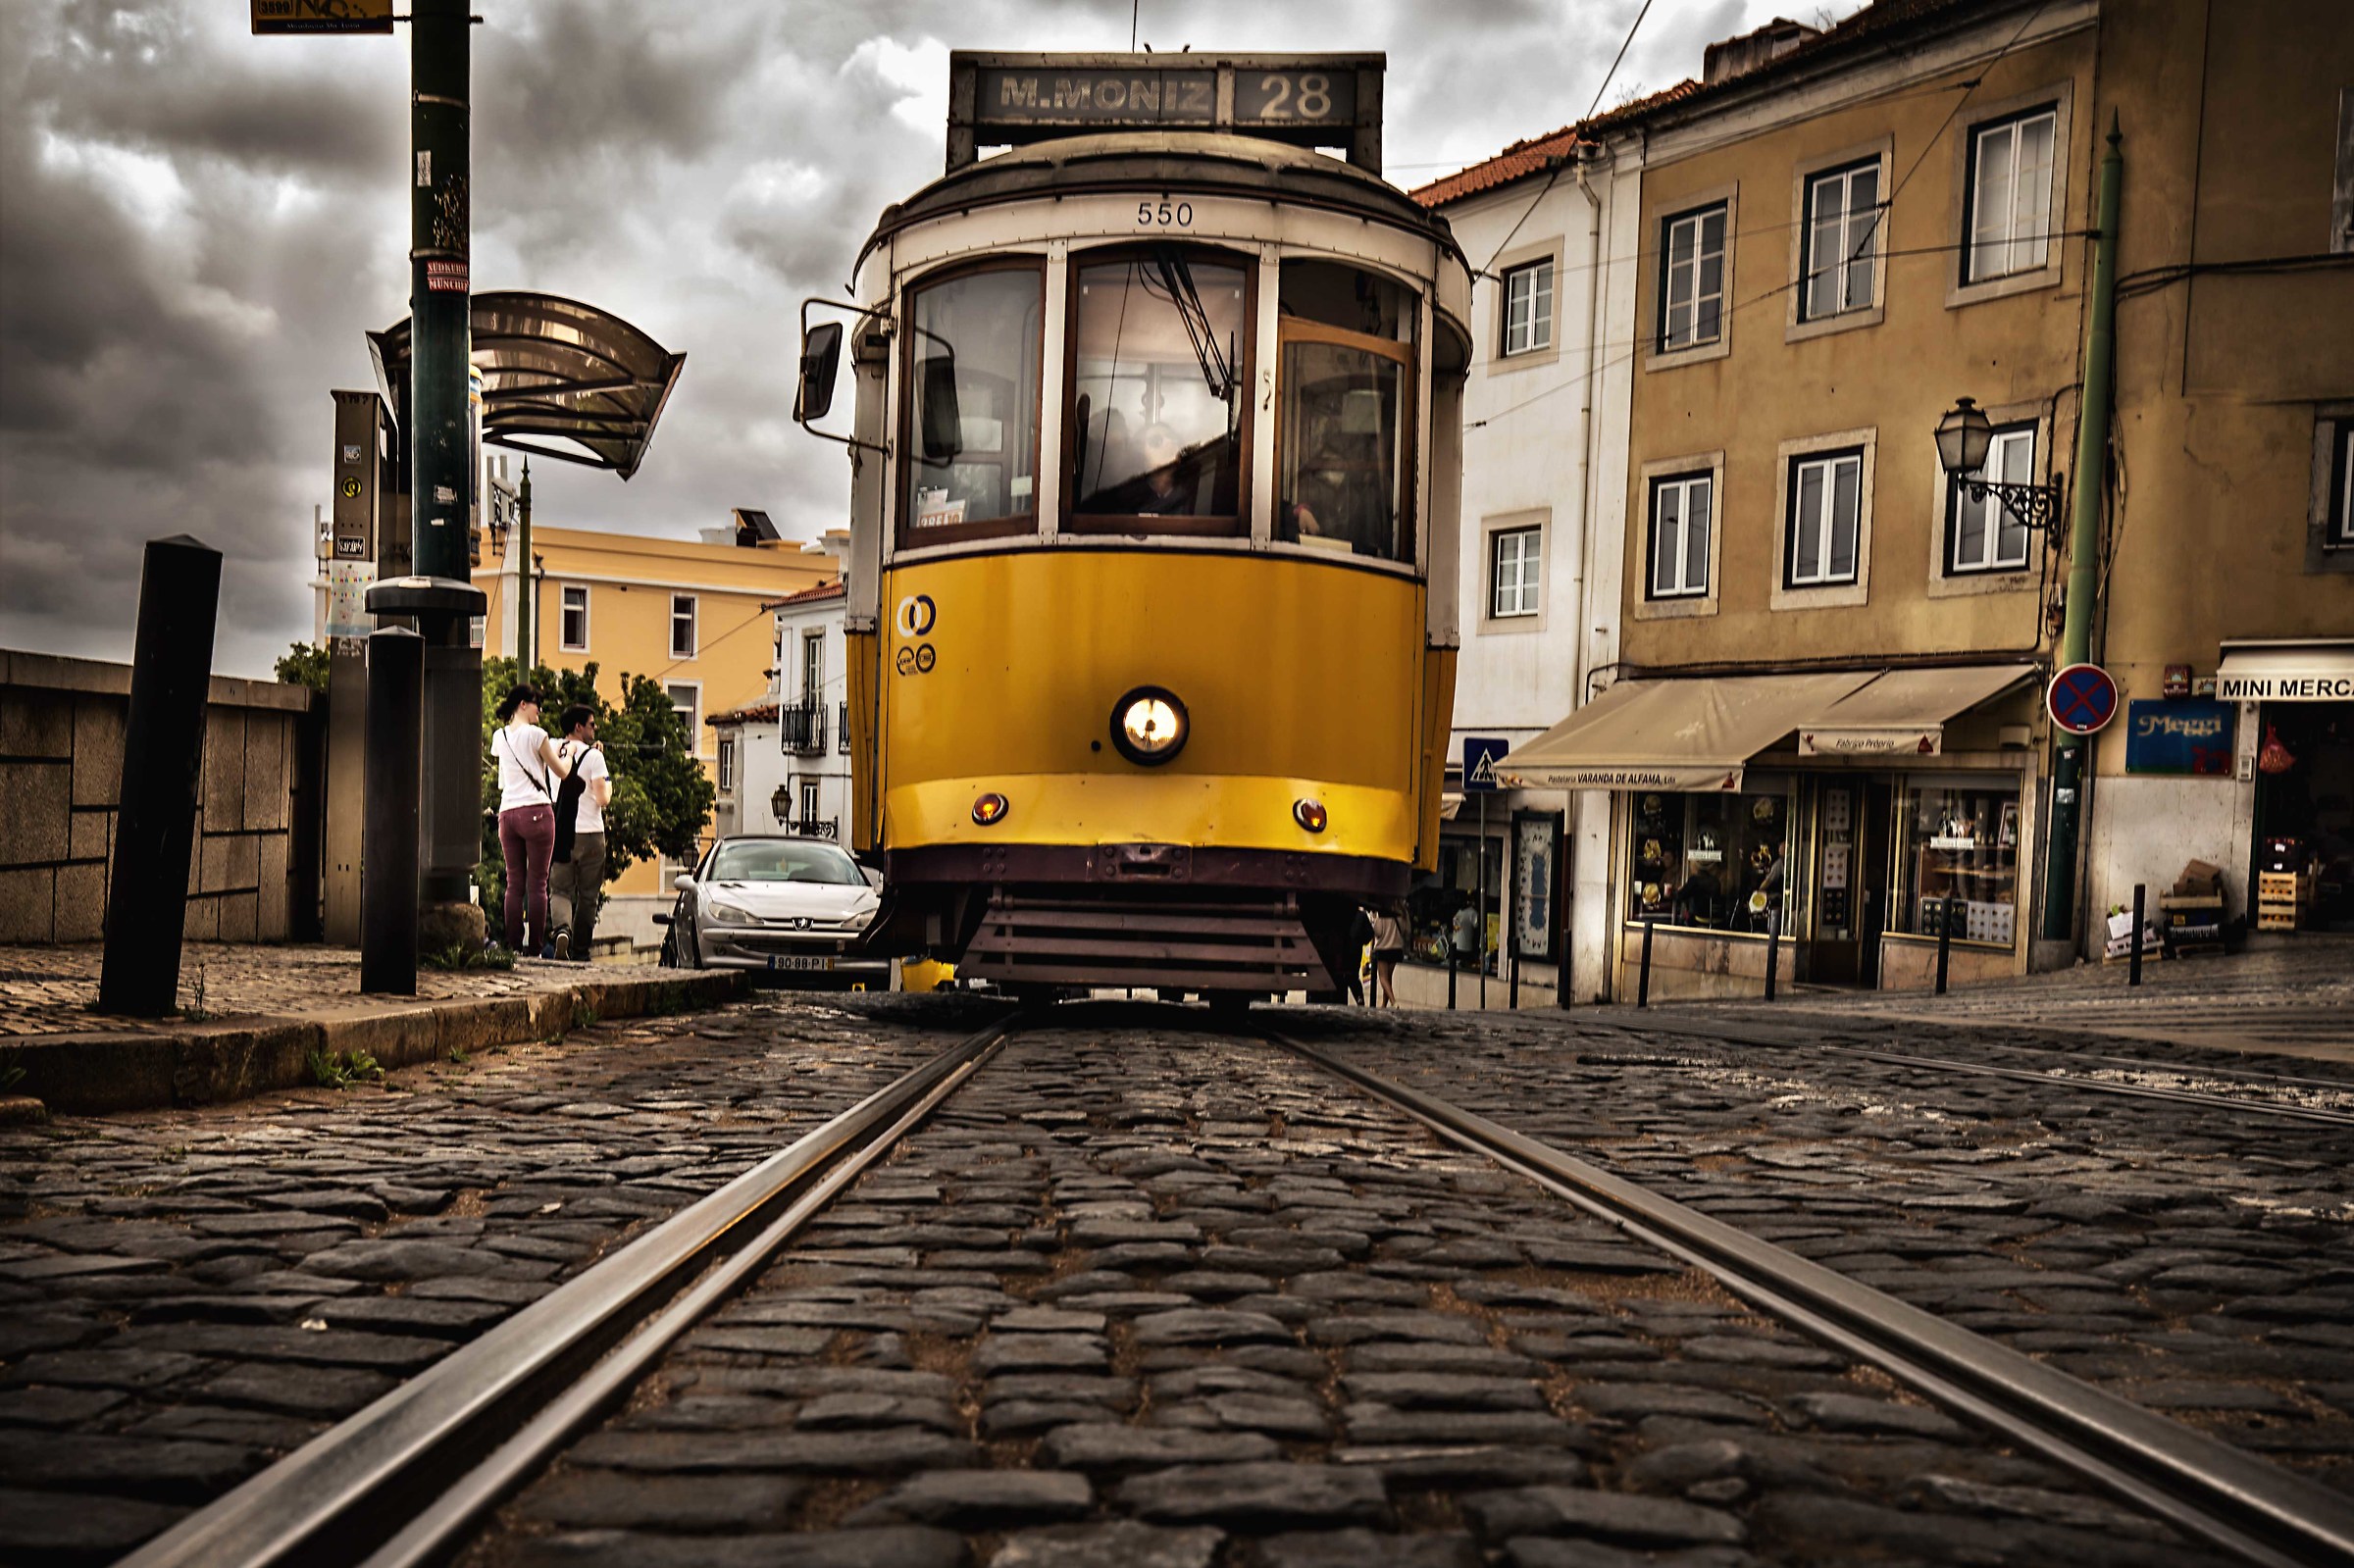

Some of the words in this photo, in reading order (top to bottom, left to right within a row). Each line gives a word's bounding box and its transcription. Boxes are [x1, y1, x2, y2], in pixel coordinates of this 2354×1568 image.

[1000, 76, 1210, 111] M.MONIZ
[1260, 75, 1331, 119] 28
[1138, 202, 1194, 228] 550
[2223, 680, 2272, 697] MINI
[2279, 680, 2354, 697] MERC
[1577, 773, 1613, 784] VARANDA
[1615, 773, 1627, 784] DE
[1628, 773, 1663, 784] ALFAMA,
